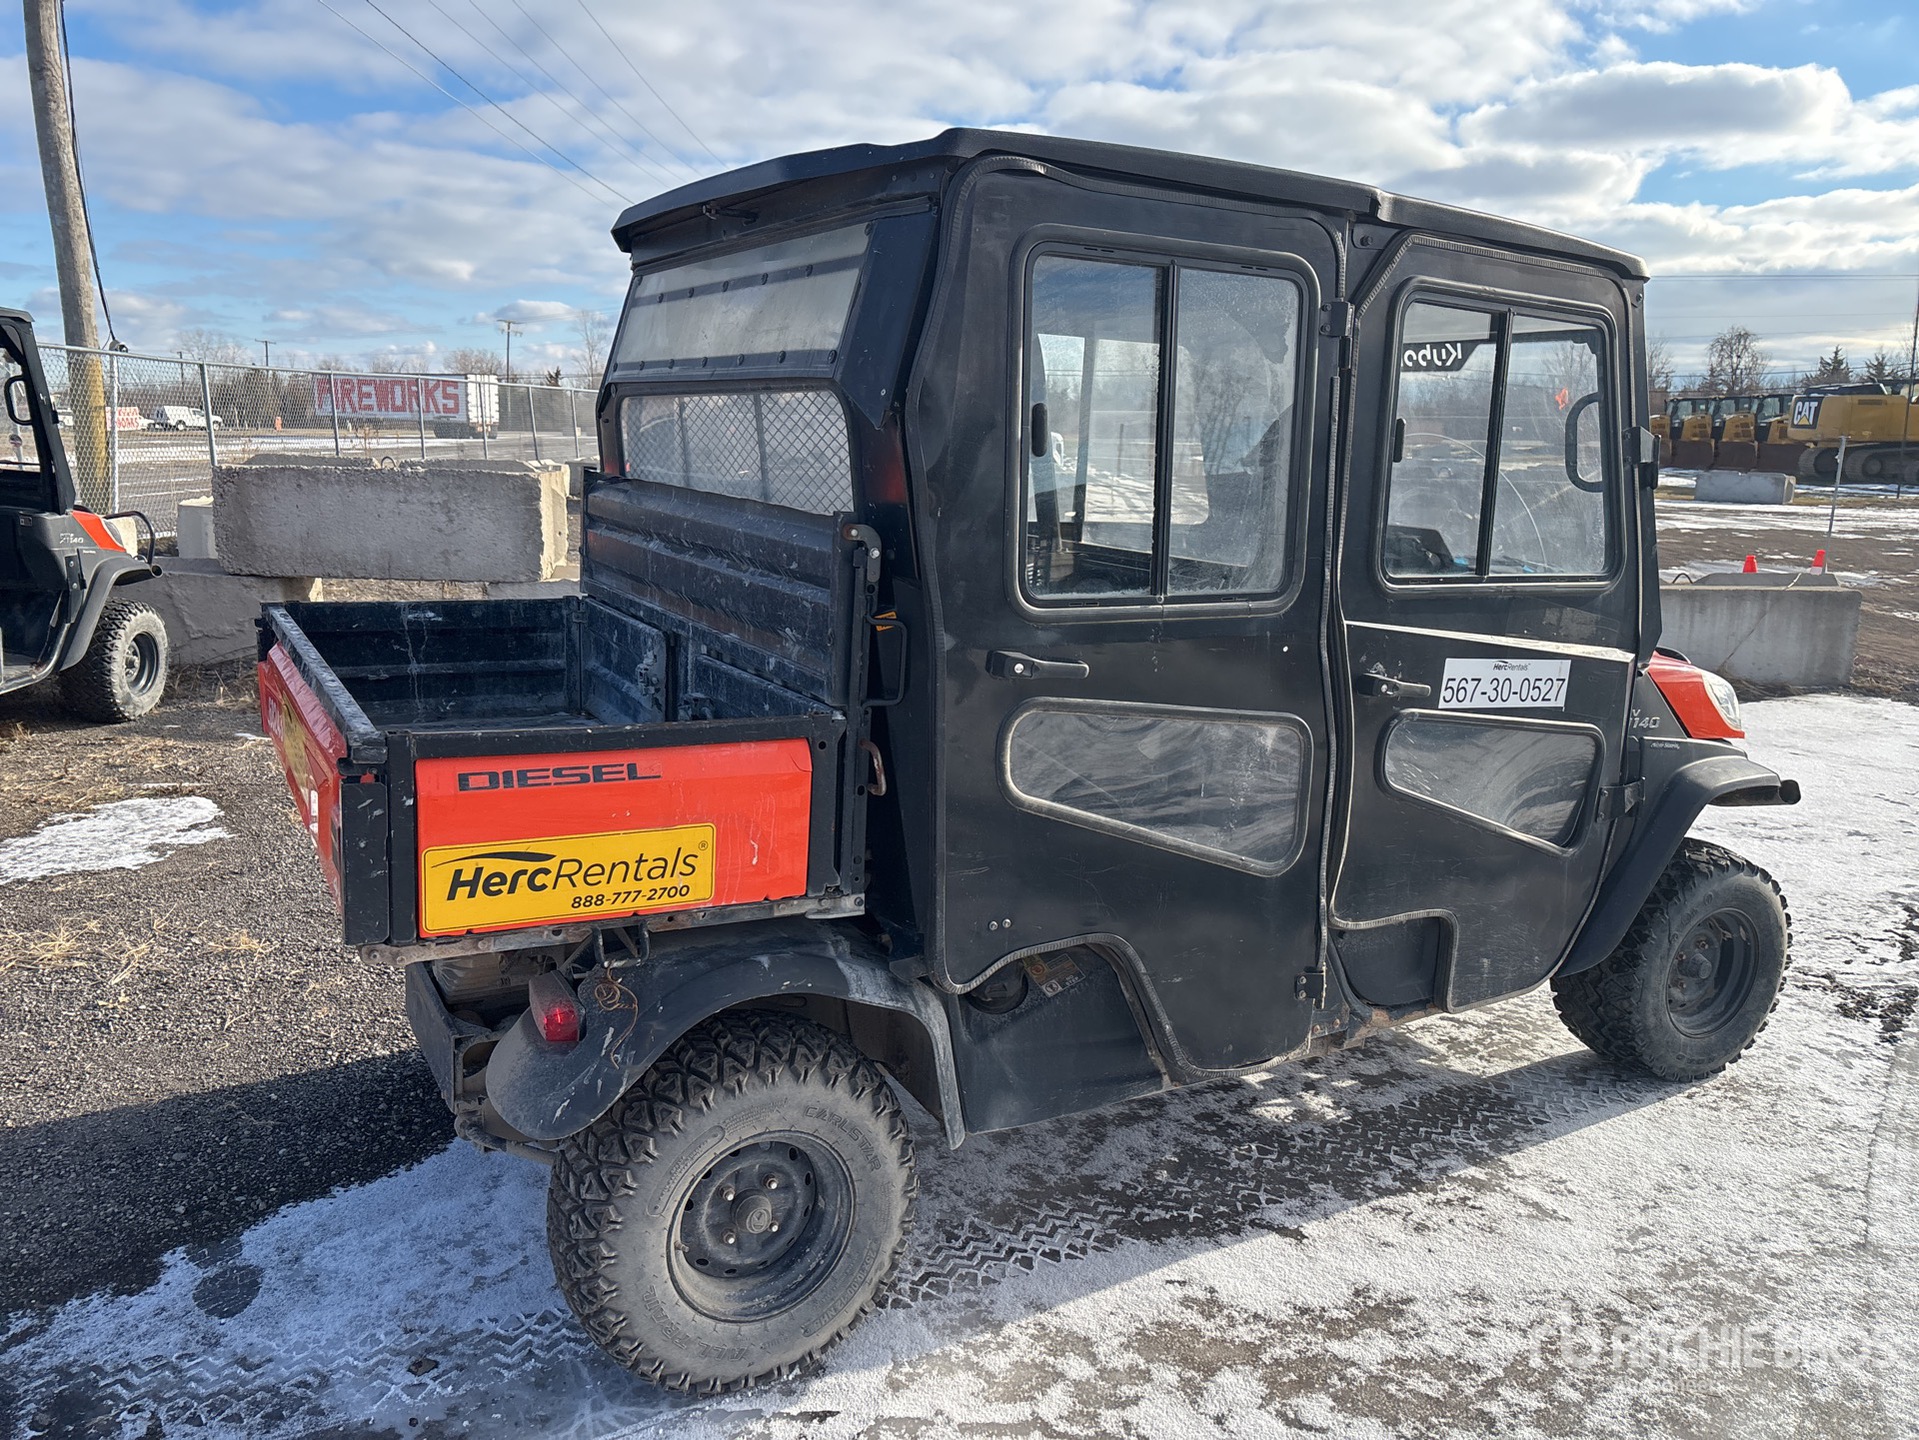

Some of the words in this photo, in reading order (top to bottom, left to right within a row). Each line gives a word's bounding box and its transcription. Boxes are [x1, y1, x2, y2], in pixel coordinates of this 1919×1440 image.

[316, 377, 460, 414] FIREWORKS
[1793, 401, 1818, 425] CAT
[1442, 677, 1566, 703] 567-30-0527
[458, 762, 662, 791] DIESEL
[446, 846, 699, 901] HercRentals
[571, 884, 690, 909] 888-777-2700
[802, 1103, 882, 1172] CARLSTAR
